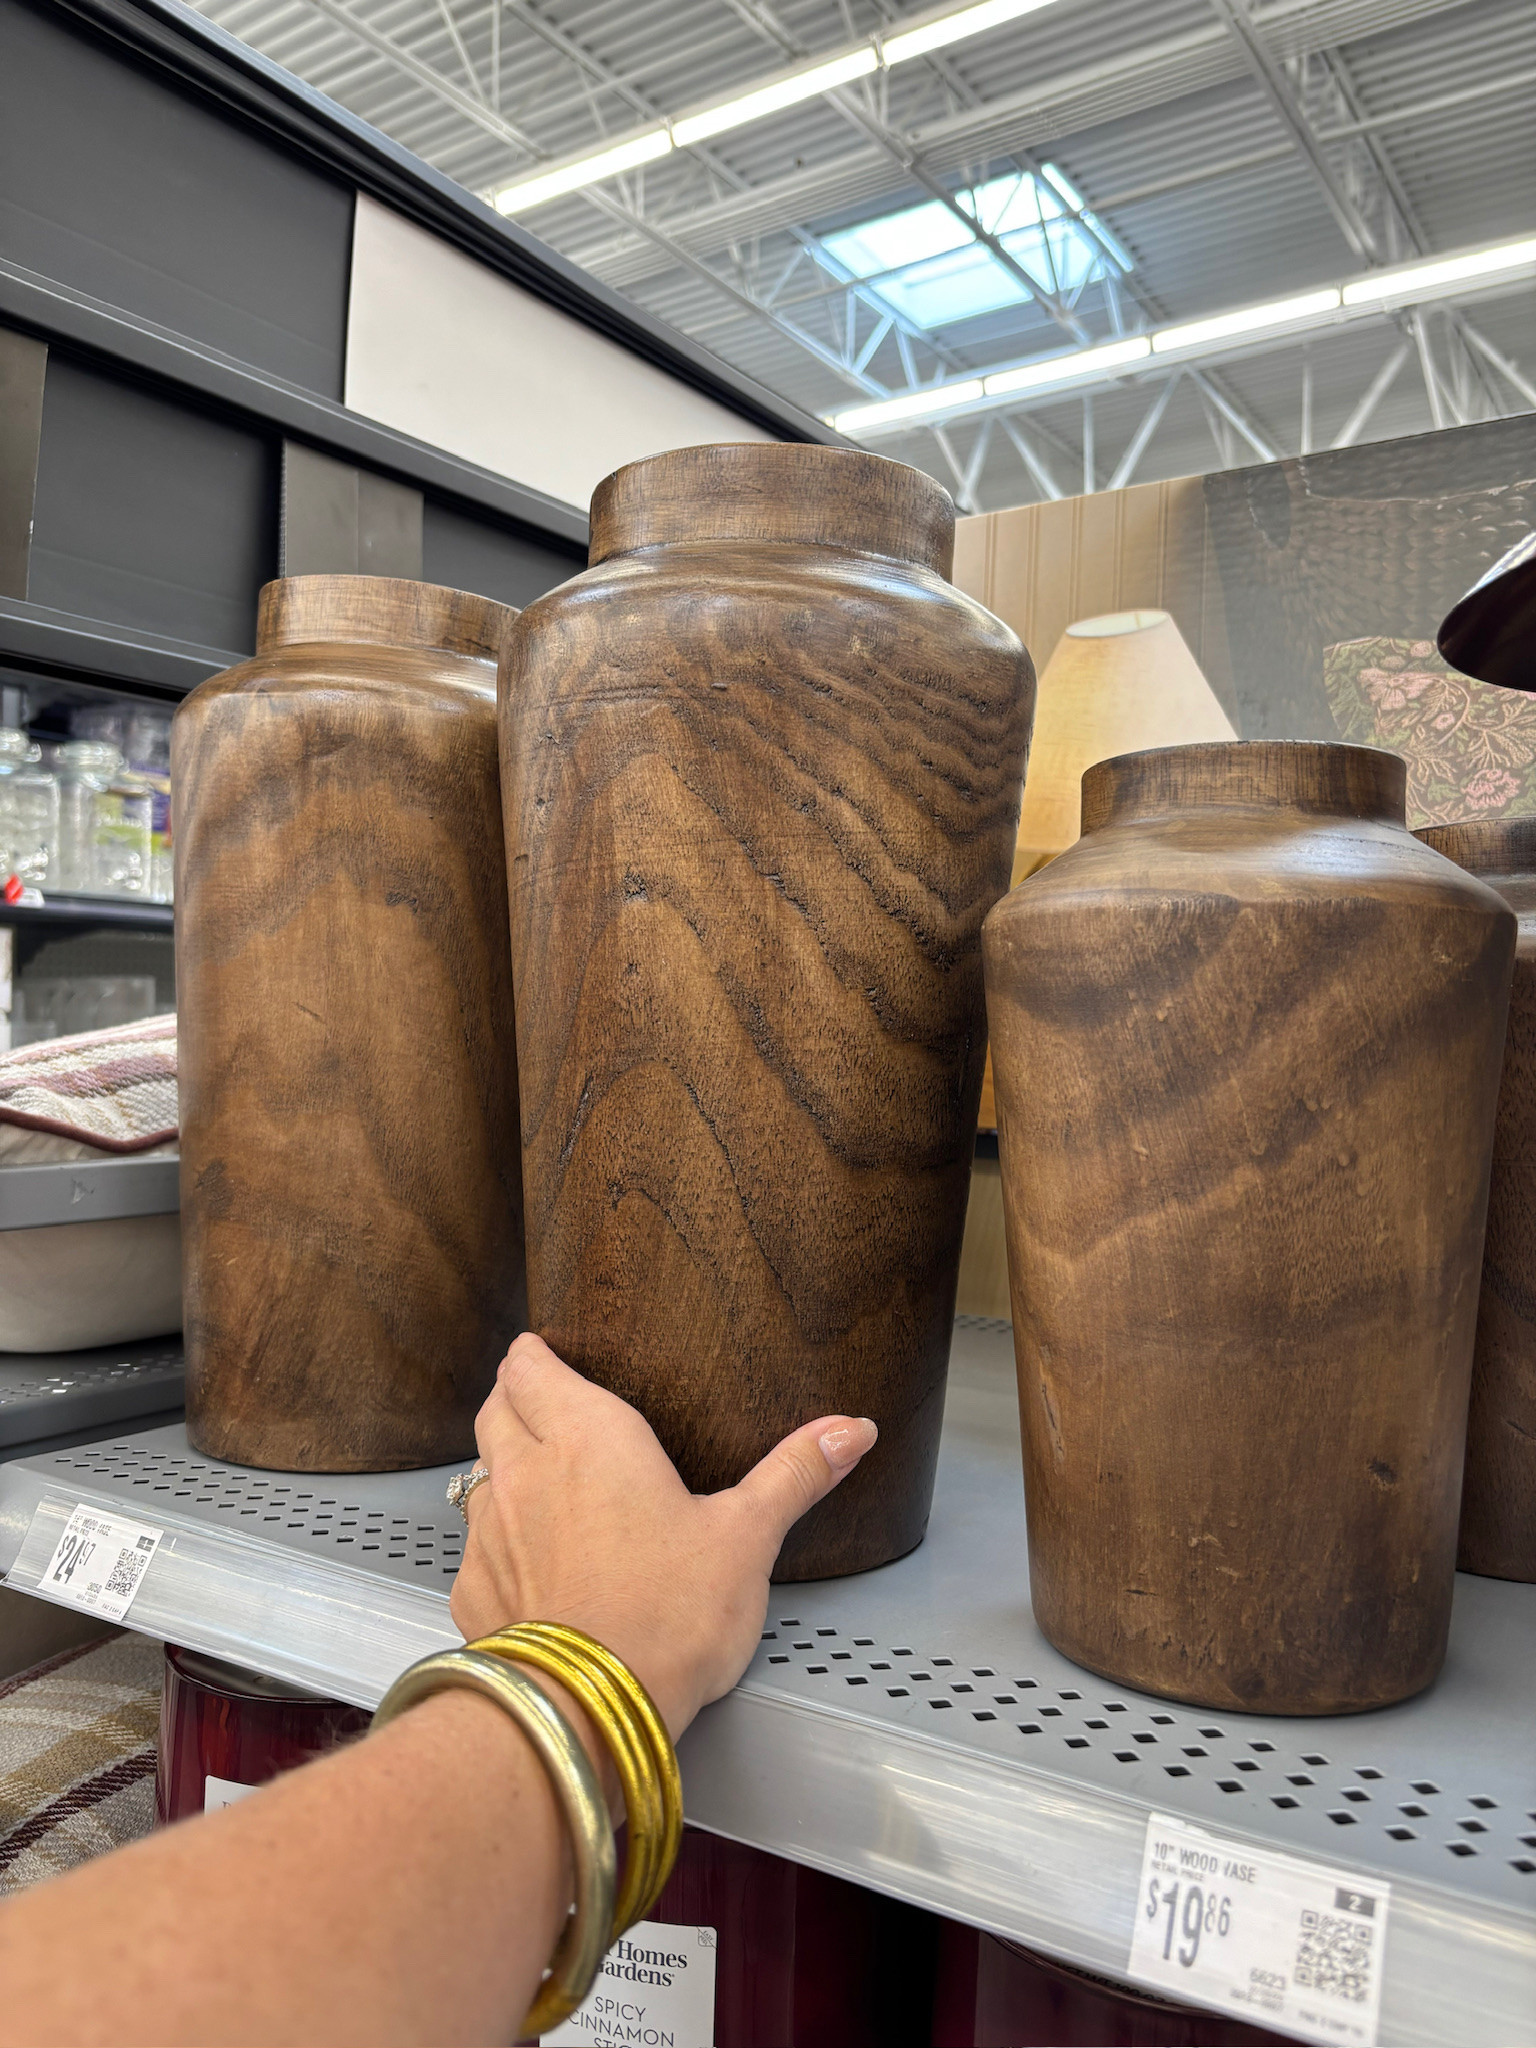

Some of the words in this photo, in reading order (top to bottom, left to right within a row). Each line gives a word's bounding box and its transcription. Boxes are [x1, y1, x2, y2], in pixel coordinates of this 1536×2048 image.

[1180, 1847, 1218, 1873] WOOD
[617, 1939, 689, 1969] Homes
[594, 1996, 647, 2022] SPICY
[569, 2008, 675, 2048] CINNAMON
